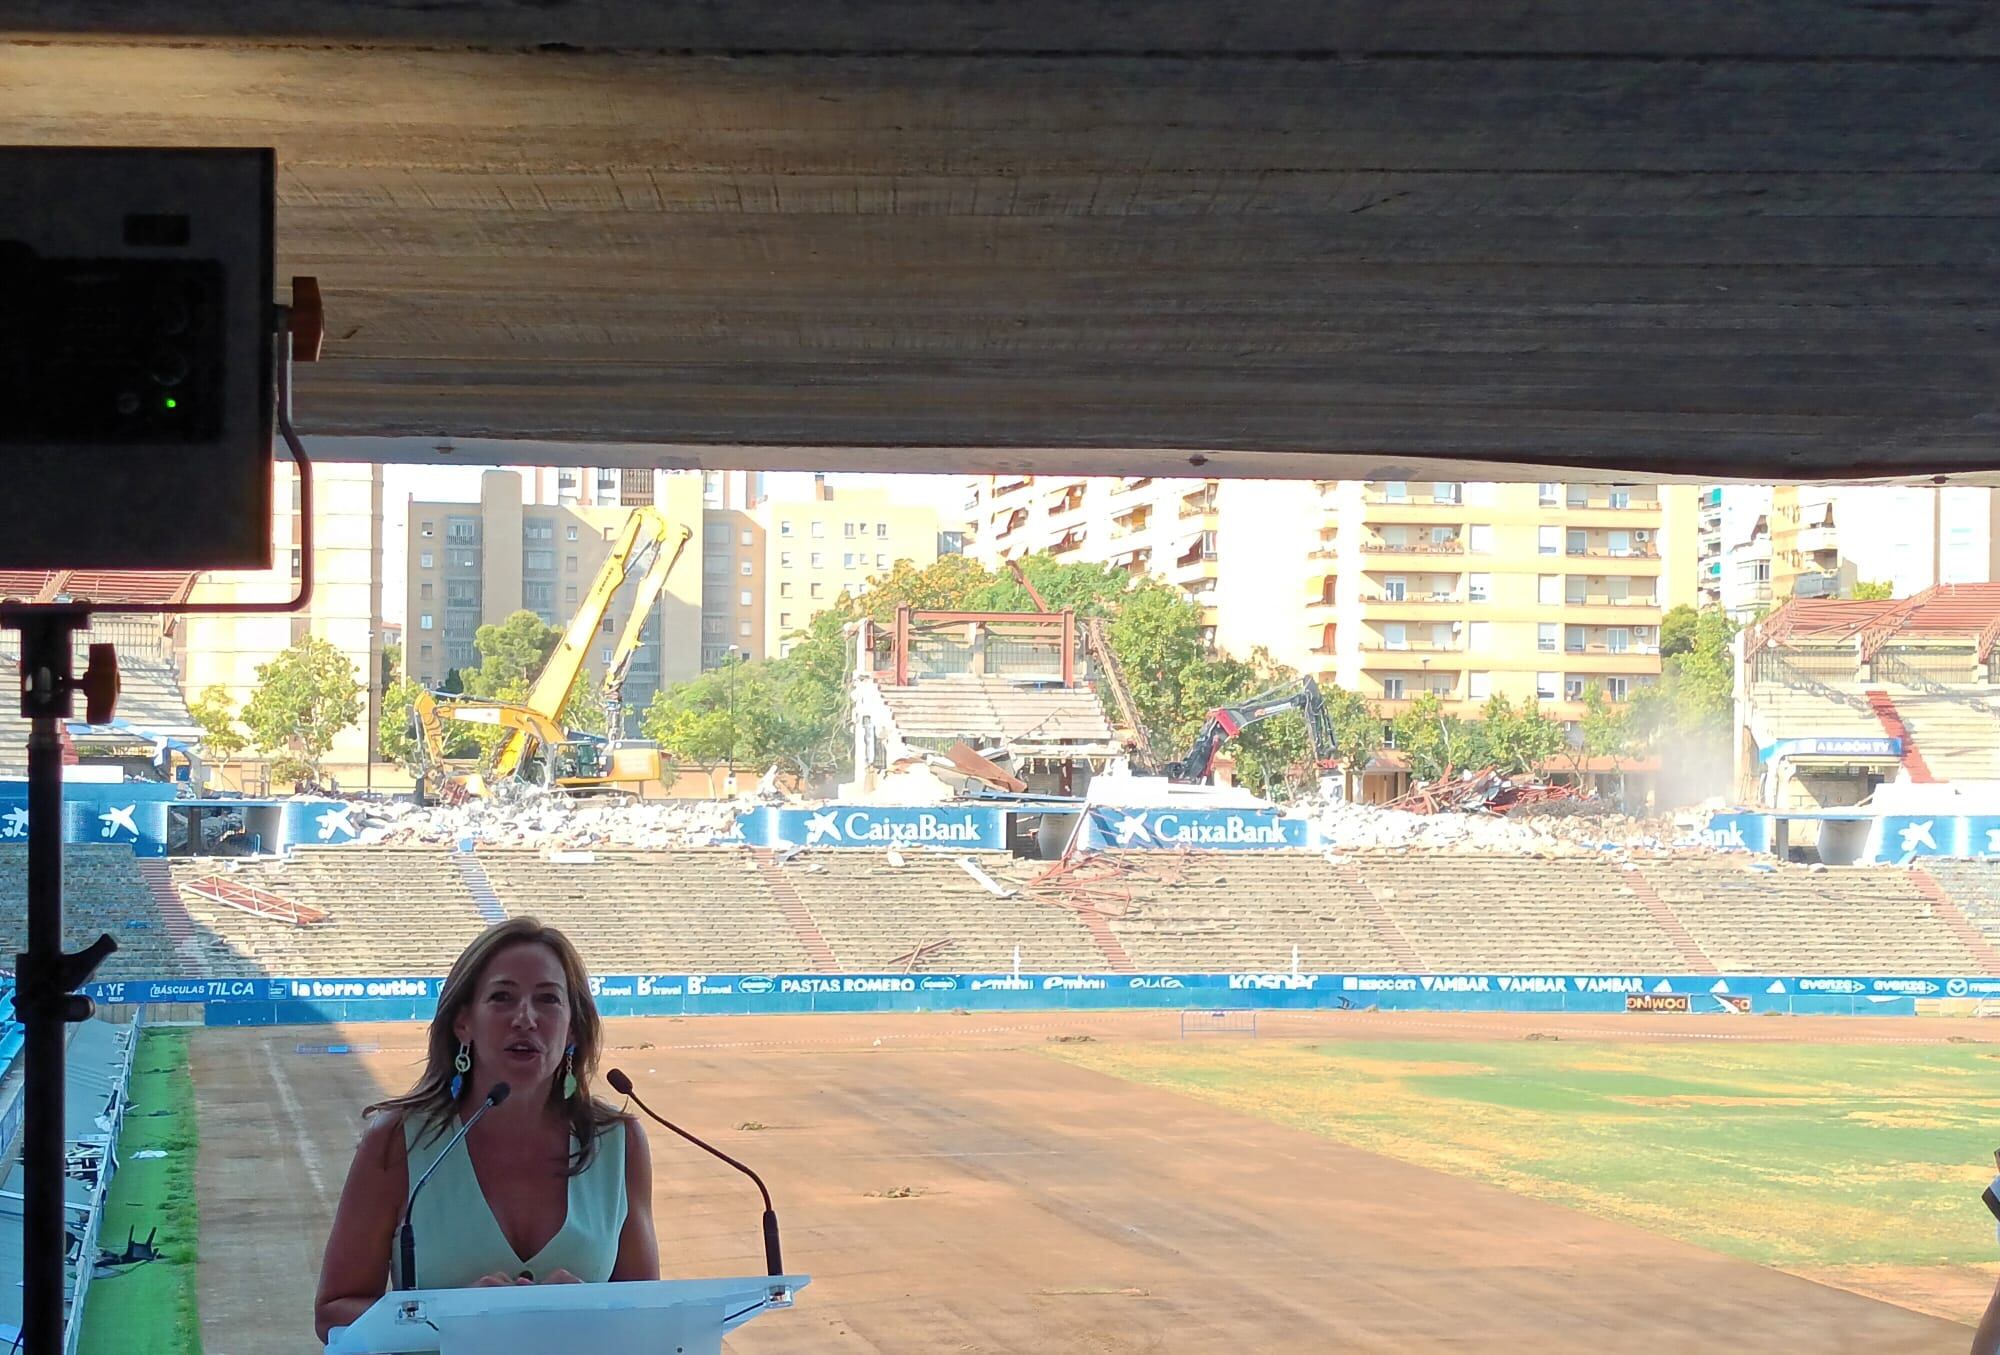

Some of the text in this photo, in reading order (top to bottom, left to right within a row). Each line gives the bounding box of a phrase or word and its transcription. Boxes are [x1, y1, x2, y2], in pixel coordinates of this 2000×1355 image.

[845, 812, 981, 841] CaixaBank
[1154, 814, 1287, 844] CaixaBank
[207, 982, 254, 995] TILCA
[291, 980, 310, 997] la
[313, 981, 363, 997] torre
[366, 979, 427, 996] outlet
[781, 978, 915, 993] PASTAS ROMERO
